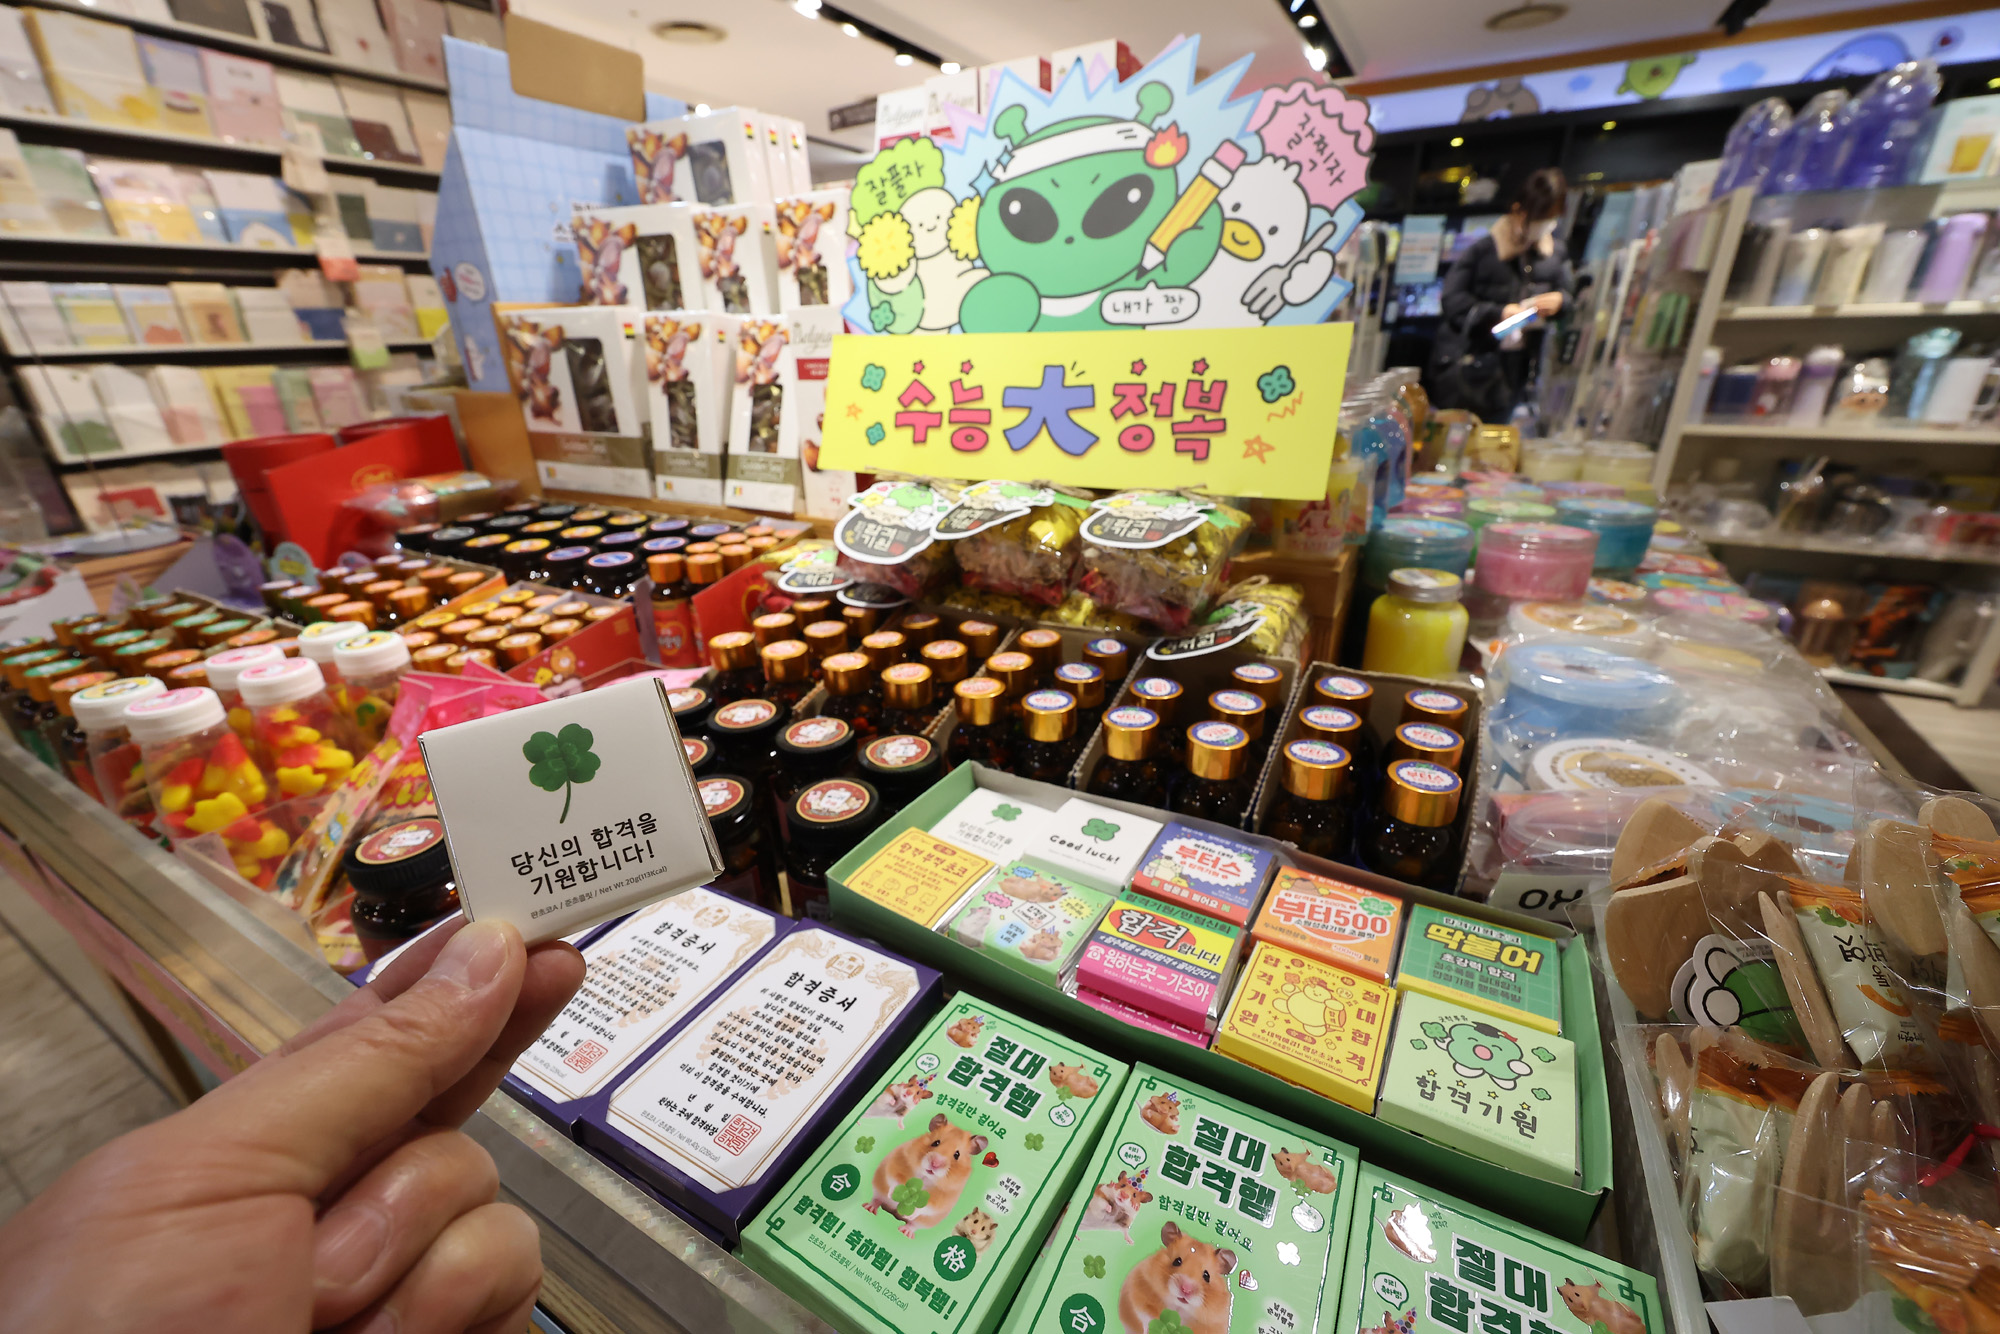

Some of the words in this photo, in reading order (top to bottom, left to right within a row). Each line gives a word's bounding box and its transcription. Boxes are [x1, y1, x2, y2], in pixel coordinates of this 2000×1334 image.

[865, 161, 924, 205] 잘풀자
[1112, 296, 1152, 316] 내가
[1163, 294, 1186, 313] 짱
[510, 836, 584, 877] 당신의
[590, 812, 658, 850] 합격을
[1050, 835, 1083, 851] Good
[1085, 847, 1120, 864] luck!
[1176, 845, 1241, 877] 부터스
[531, 839, 656, 896] 기원합니다!
[599, 886, 613, 895] Net
[1116, 909, 1190, 950] 합격
[1273, 897, 1387, 934] 부터500
[654, 921, 716, 955] 합격증서
[1177, 943, 1222, 966] 합니다!
[1440, 953, 1483, 972] 초강력
[1486, 965, 1517, 982] 합격
[784, 971, 857, 1012] 합격증서
[726, 1011, 753, 1027] 누구보다
[753, 1024, 774, 1039] 뛰어난
[774, 1033, 796, 1049] 실력을
[752, 1011, 773, 1024] 뜨거운
[773, 1021, 795, 1035] 열정과
[794, 1030, 817, 1046] 열의로
[763, 1002, 784, 1016] 남다른
[784, 1012, 807, 1027] 노력과
[768, 990, 788, 1004] 사람은
[815, 1012, 845, 1034] 공부하고,
[736, 1030, 757, 1045] 노력과
[757, 1041, 779, 1057] 최선을
[983, 1035, 1047, 1080] 절대
[708, 1062, 731, 1079] 합격할
[729, 1074, 760, 1095] 것이기에
[737, 1060, 759, 1078] 원하는
[759, 1073, 778, 1087] 곳에
[739, 1045, 747, 1054] 더
[746, 1050, 762, 1063] 높은
[761, 1058, 784, 1076] 점수를
[784, 1070, 802, 1085] 받아
[680, 1063, 695, 1074] 미리
[694, 1070, 703, 1079] 이
[701, 1075, 731, 1096] 합격증을
[730, 1092, 768, 1119] 수여합니다.
[947, 1055, 1041, 1119] 합격햄
[658, 1096, 678, 1113] 원하는
[676, 1107, 693, 1121] 곳에
[721, 1113, 731, 1123] 일
[936, 1093, 977, 1119] 합격길만
[978, 1113, 1007, 1140] 걸어요
[1416, 1075, 1537, 1140] 합격기원
[1194, 1117, 1267, 1173] 절대
[829, 1173, 851, 1193] 合
[1160, 1144, 1277, 1223] 합격햄
[1158, 1194, 1212, 1227] 합격길만
[1215, 1218, 1253, 1253] 걸어요
[793, 1195, 846, 1238] 합격햄!
[845, 1229, 899, 1277] 축하햄!
[898, 1266, 958, 1320] 행복햄!
[854, 1266, 866, 1279] Net
[941, 1244, 967, 1273] 格
[1456, 1237, 1548, 1313] 절대
[1069, 1306, 1097, 1333] 合
